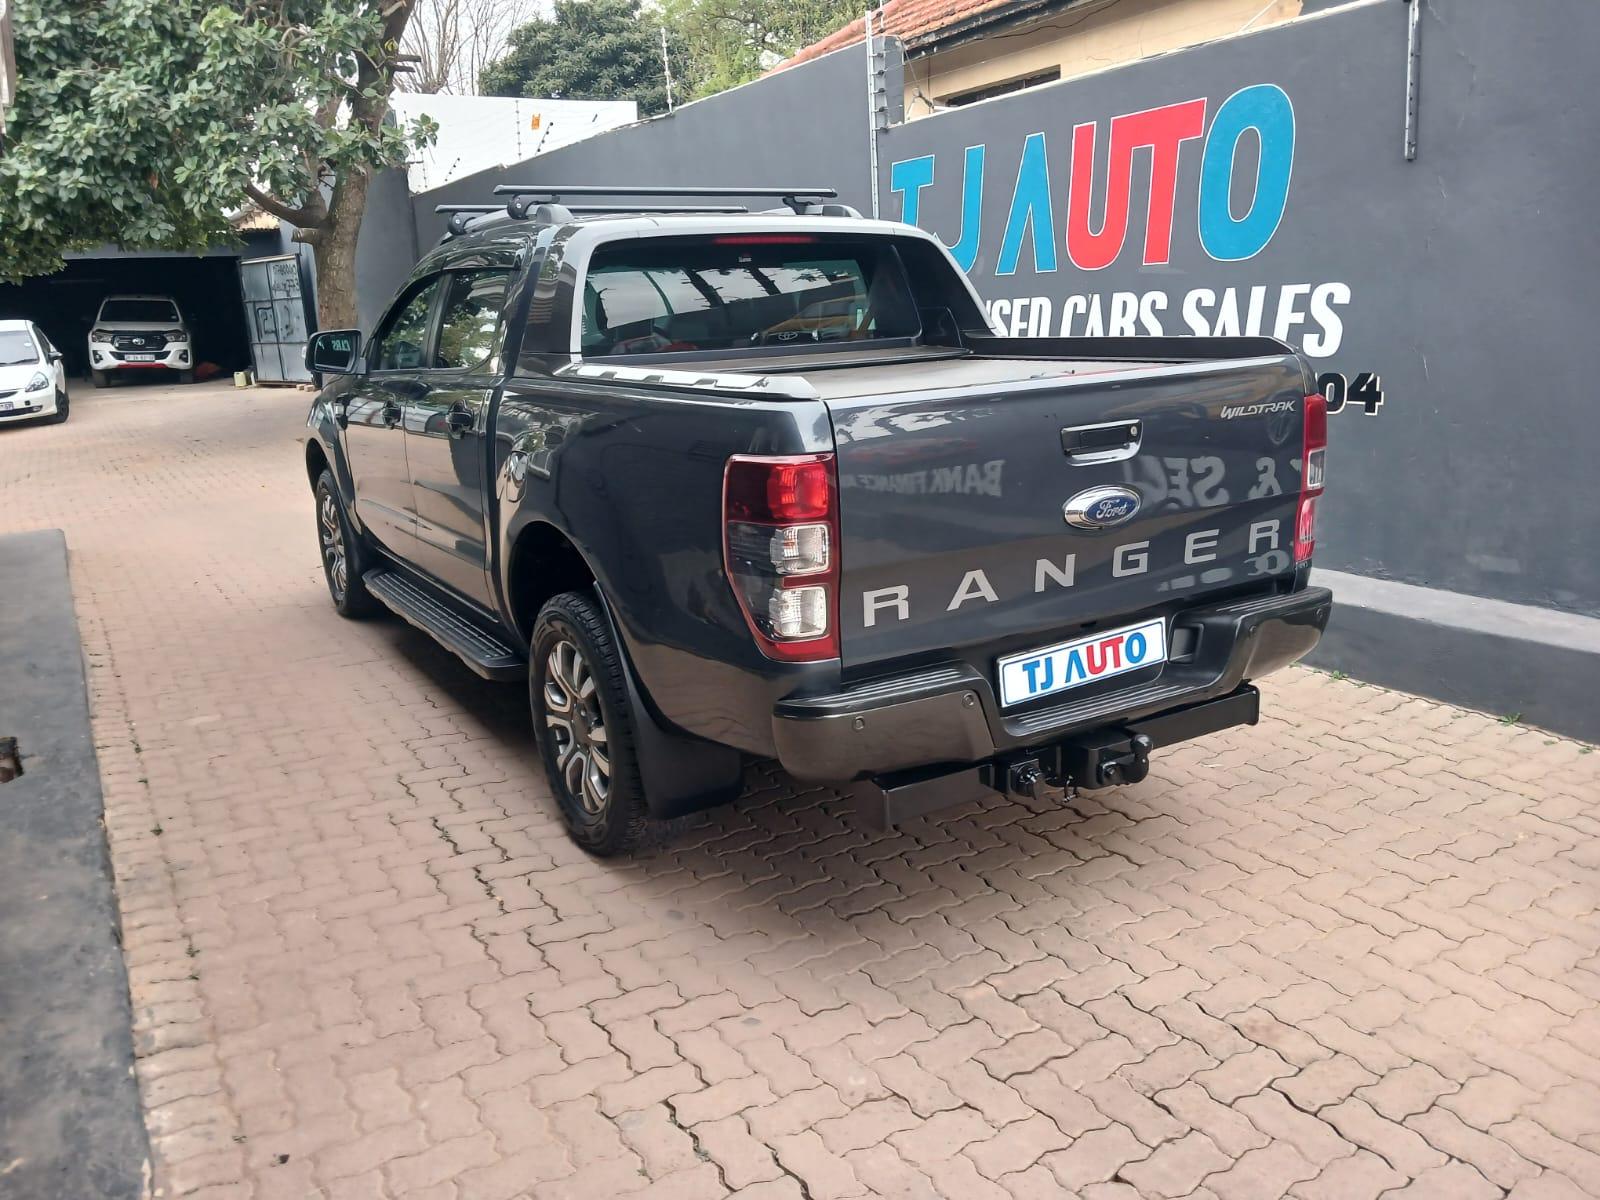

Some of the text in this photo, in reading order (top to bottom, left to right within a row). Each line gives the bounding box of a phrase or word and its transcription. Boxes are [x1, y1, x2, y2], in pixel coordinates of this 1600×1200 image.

[891, 83, 1296, 276] TJ AUTO
[984, 282, 1352, 358] SED CARS SALES
[1220, 400, 1296, 420] WILDTRAK
[1096, 499, 1128, 519] Ford
[863, 519, 1280, 628] RANGER
[1022, 632, 1147, 694] TJ AUTO
